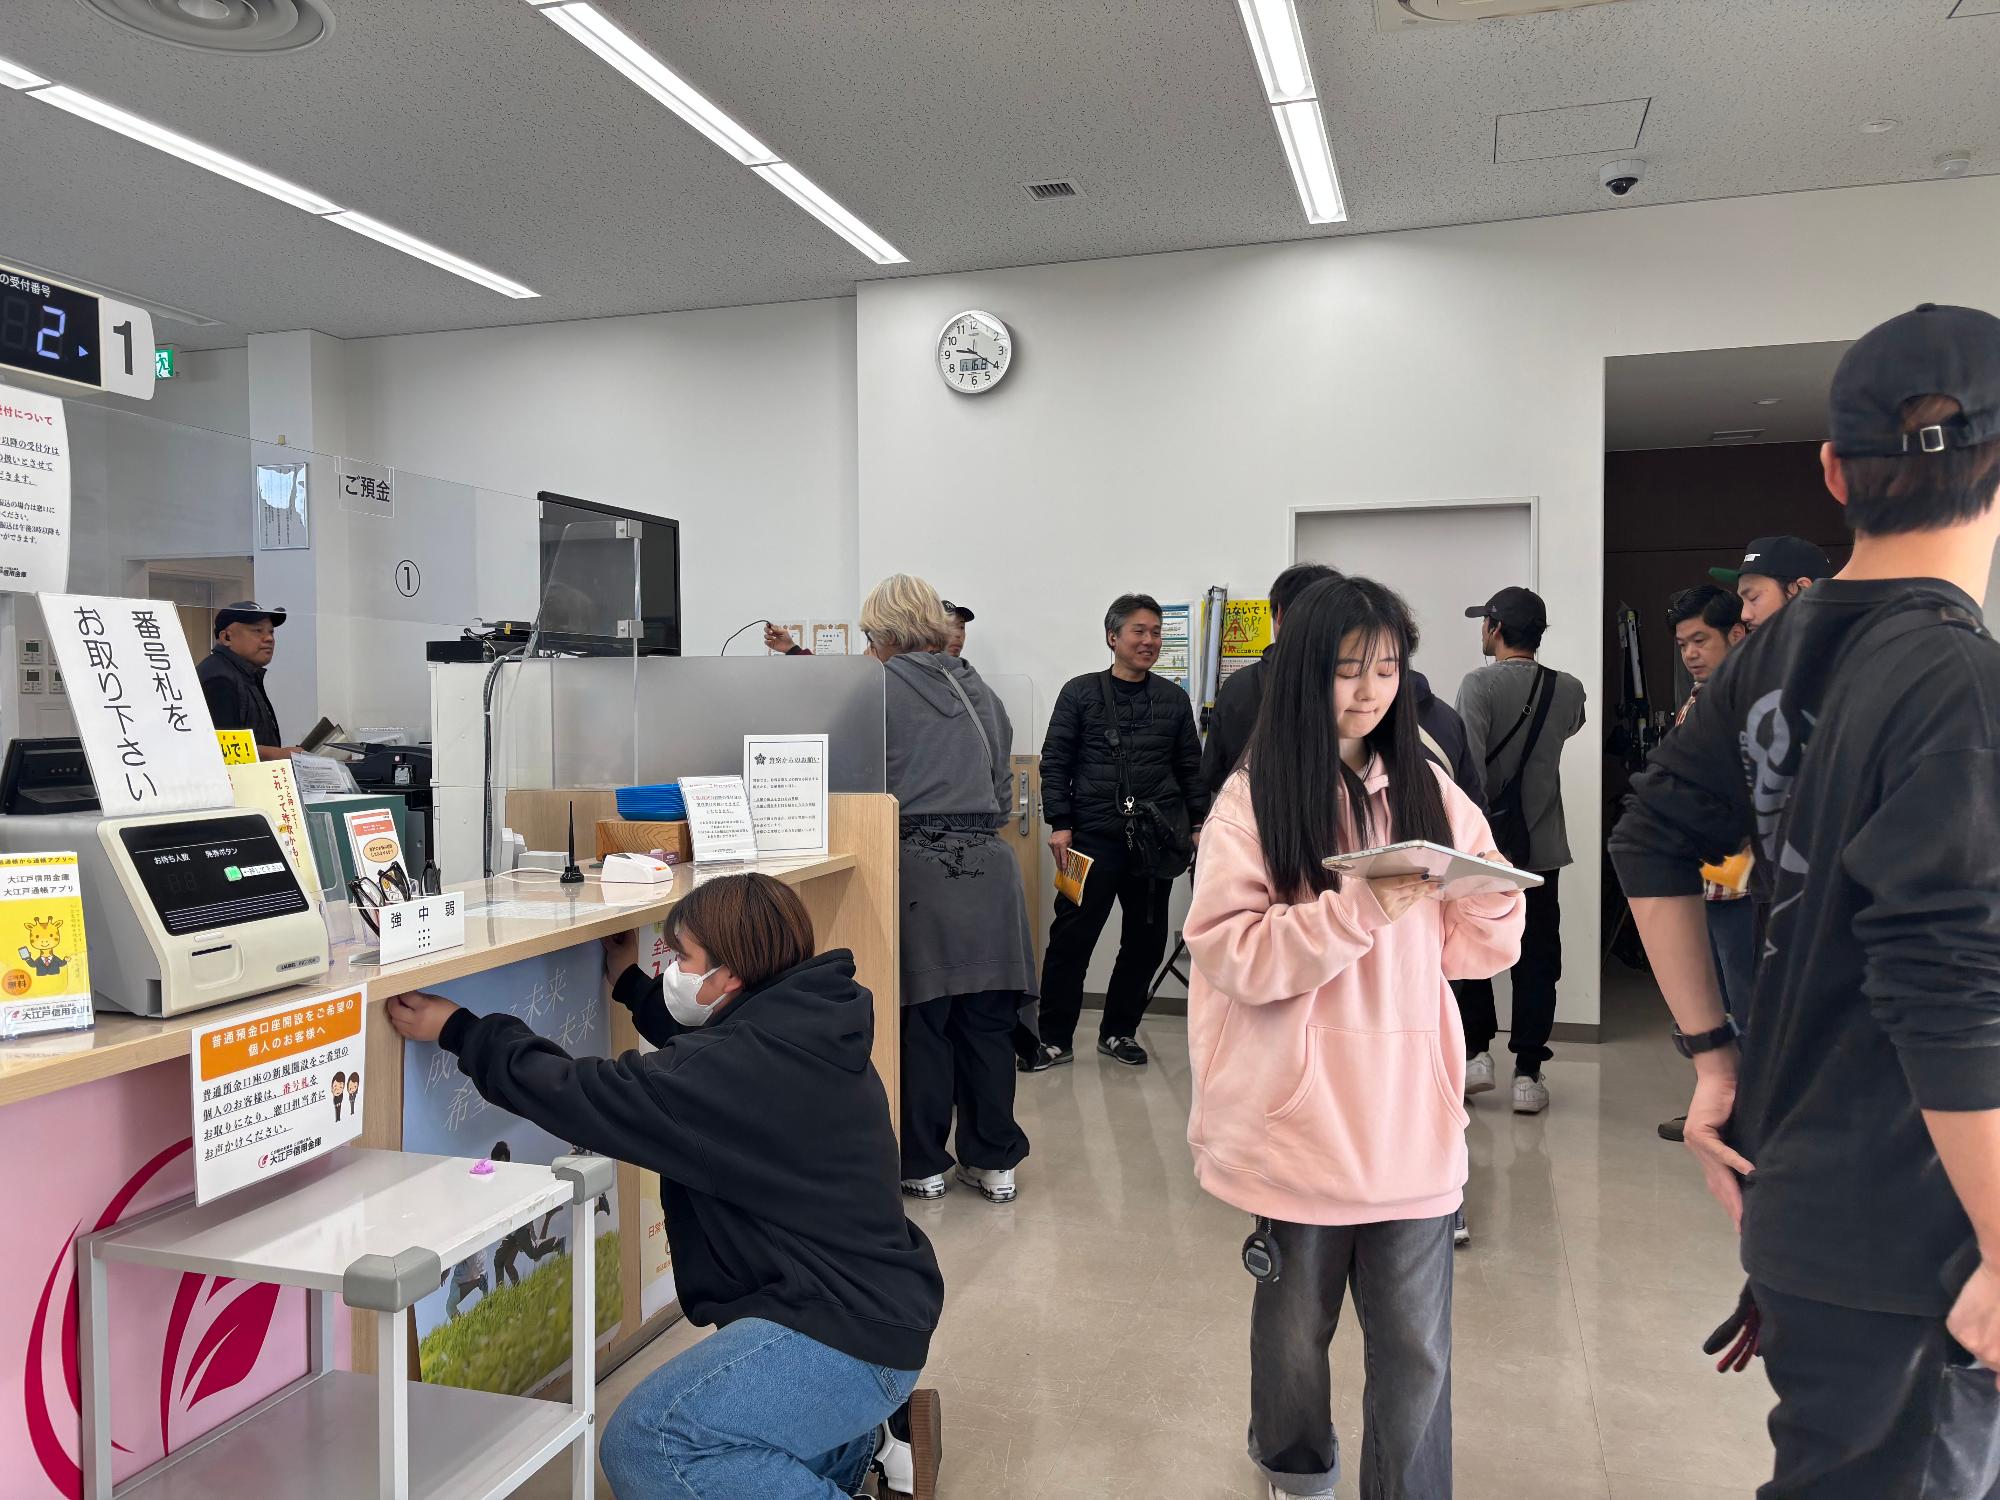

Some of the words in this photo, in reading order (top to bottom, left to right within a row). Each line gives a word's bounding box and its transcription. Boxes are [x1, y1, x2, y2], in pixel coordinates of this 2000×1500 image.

[36, 305, 66, 360] 2
[957, 325, 965, 335] 11
[948, 336, 957, 346] 10
[993, 331, 1000, 341] 2
[113, 320, 133, 376] 1
[998, 345, 1004, 356] 3
[944, 350, 951, 359] 9
[949, 363, 956, 373] 8
[959, 373, 965, 383] 7
[971, 375, 978, 386] 6
[984, 371, 991, 380] 5
[346, 475, 390, 503] ご預金
[131, 610, 192, 732] 番号札を
[73, 605, 158, 802] お取り下さい
[391, 912, 402, 929] 強
[419, 905, 429, 922] 中
[445, 900, 455, 917] 弱
[211, 999, 354, 1048] 普通預金口座開設をご希望の
[248, 1027, 326, 1057] 個人のお客様へ
